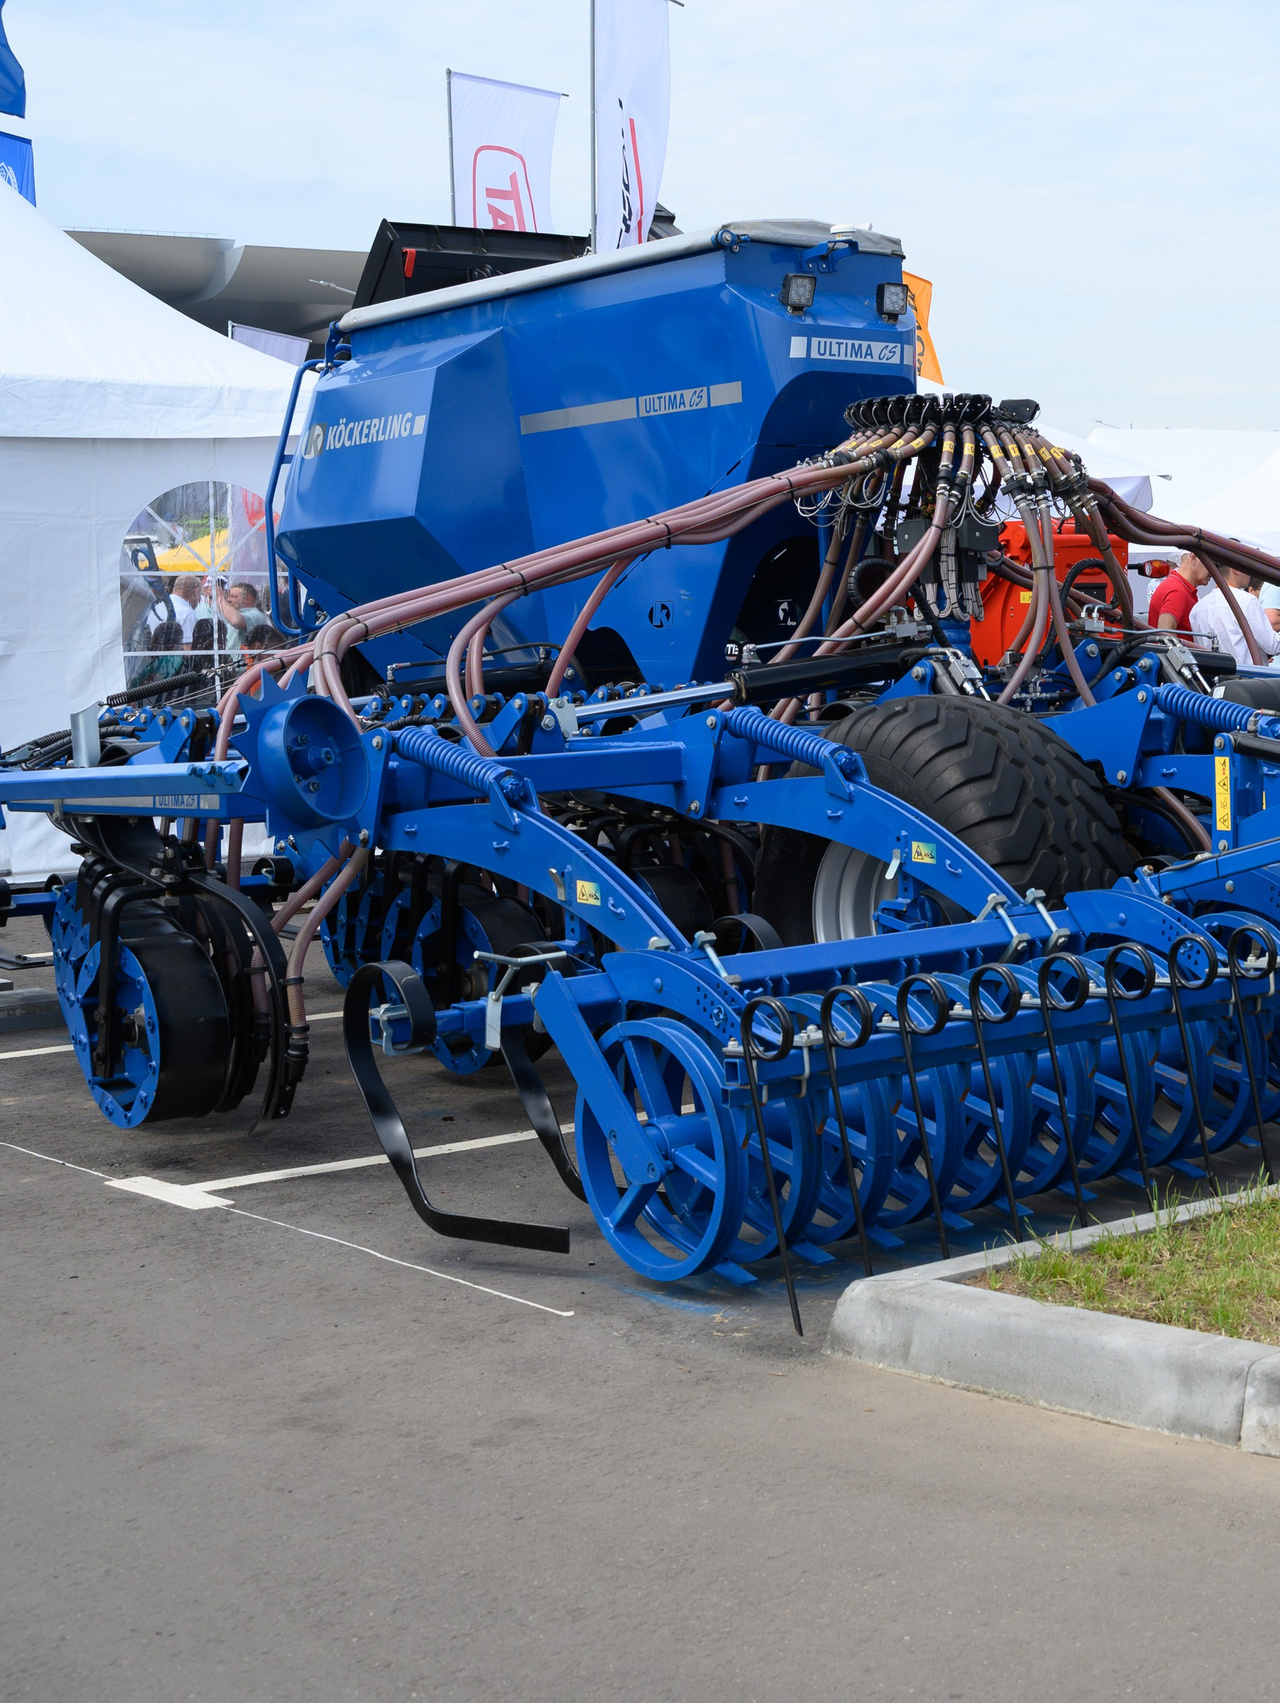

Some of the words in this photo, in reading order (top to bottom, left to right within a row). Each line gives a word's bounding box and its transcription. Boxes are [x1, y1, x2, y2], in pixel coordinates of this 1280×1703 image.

[817, 340, 875, 360] ULTIMA
[877, 344, 899, 362] CS
[644, 392, 687, 414] ULTIMA
[689, 388, 705, 408] CS
[325, 411, 413, 451] KÖCKERLING
